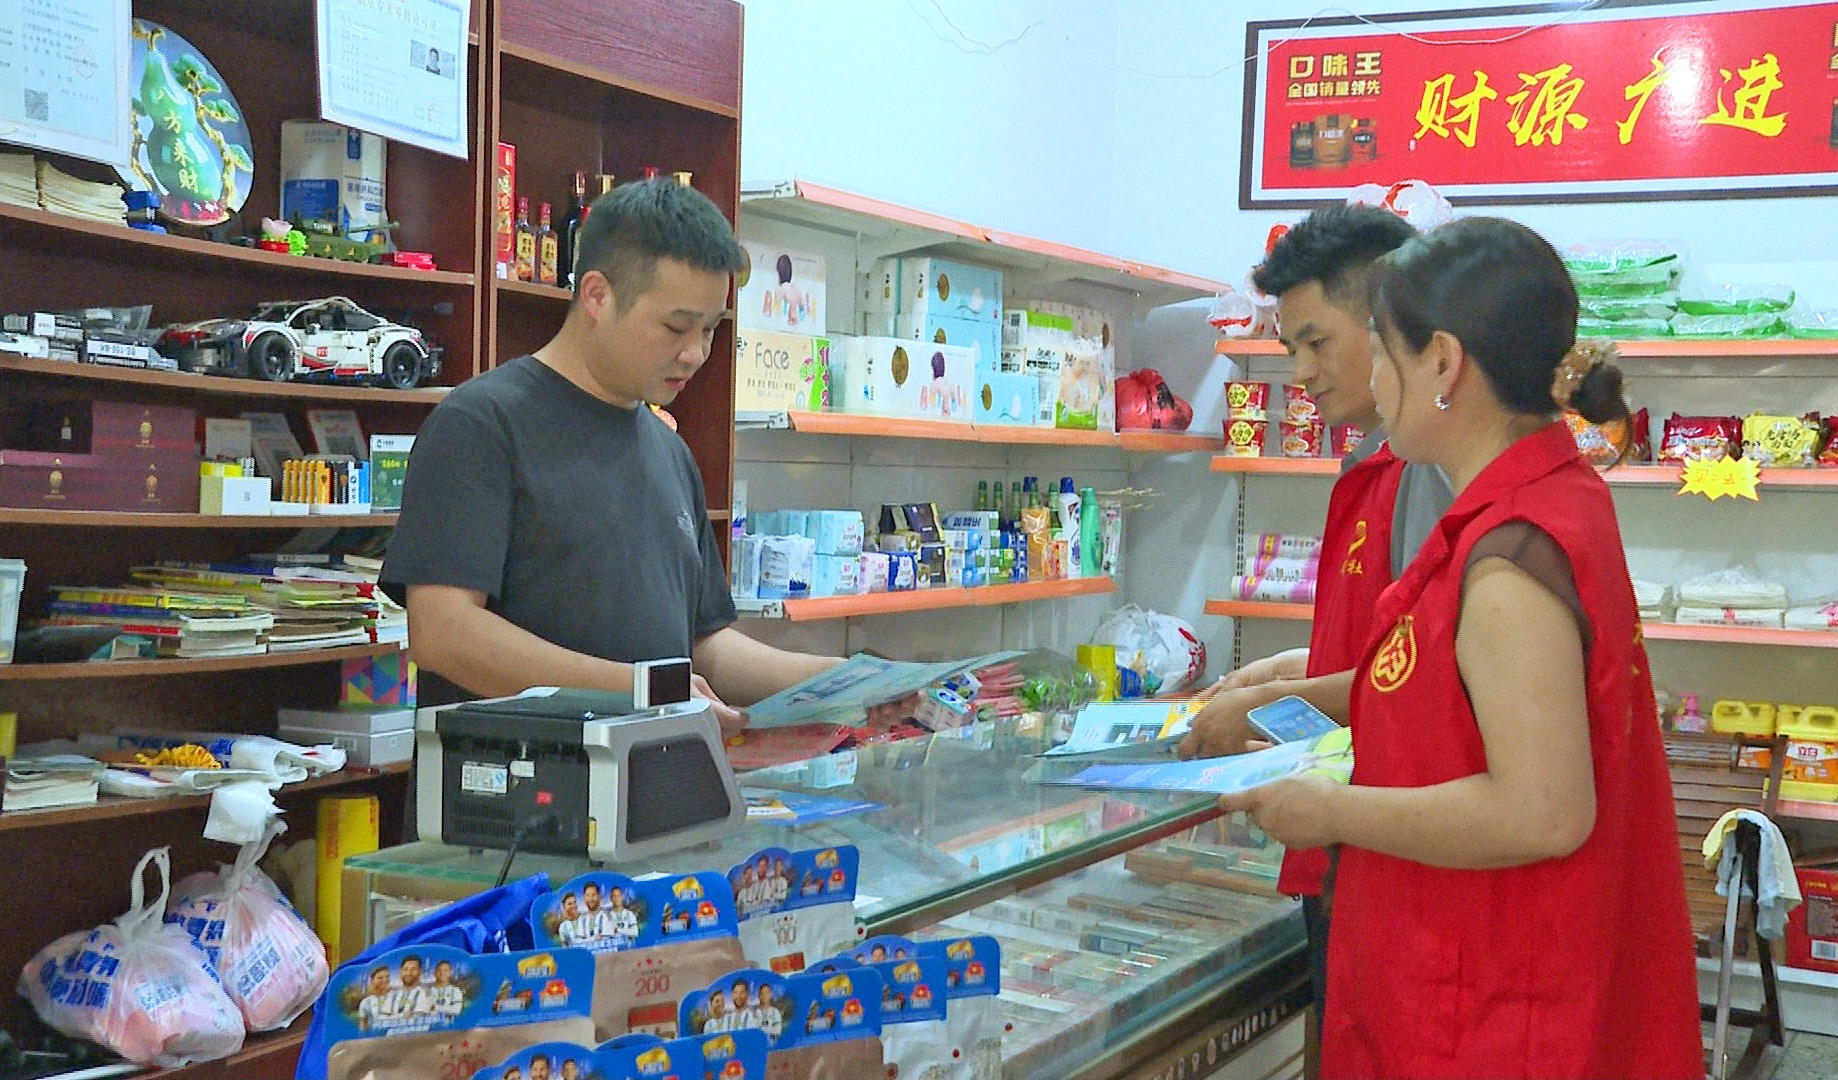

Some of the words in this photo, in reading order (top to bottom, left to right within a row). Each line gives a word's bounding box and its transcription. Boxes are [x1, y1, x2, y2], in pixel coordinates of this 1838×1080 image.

[1289, 51, 1381, 79] 口味王
[1287, 79, 1381, 98] 全国销量领先
[1414, 52, 1788, 148] 财源广进
[755, 342, 790, 370] Face
[634, 973, 671, 998] 200
[441, 1058, 488, 1080] 20
